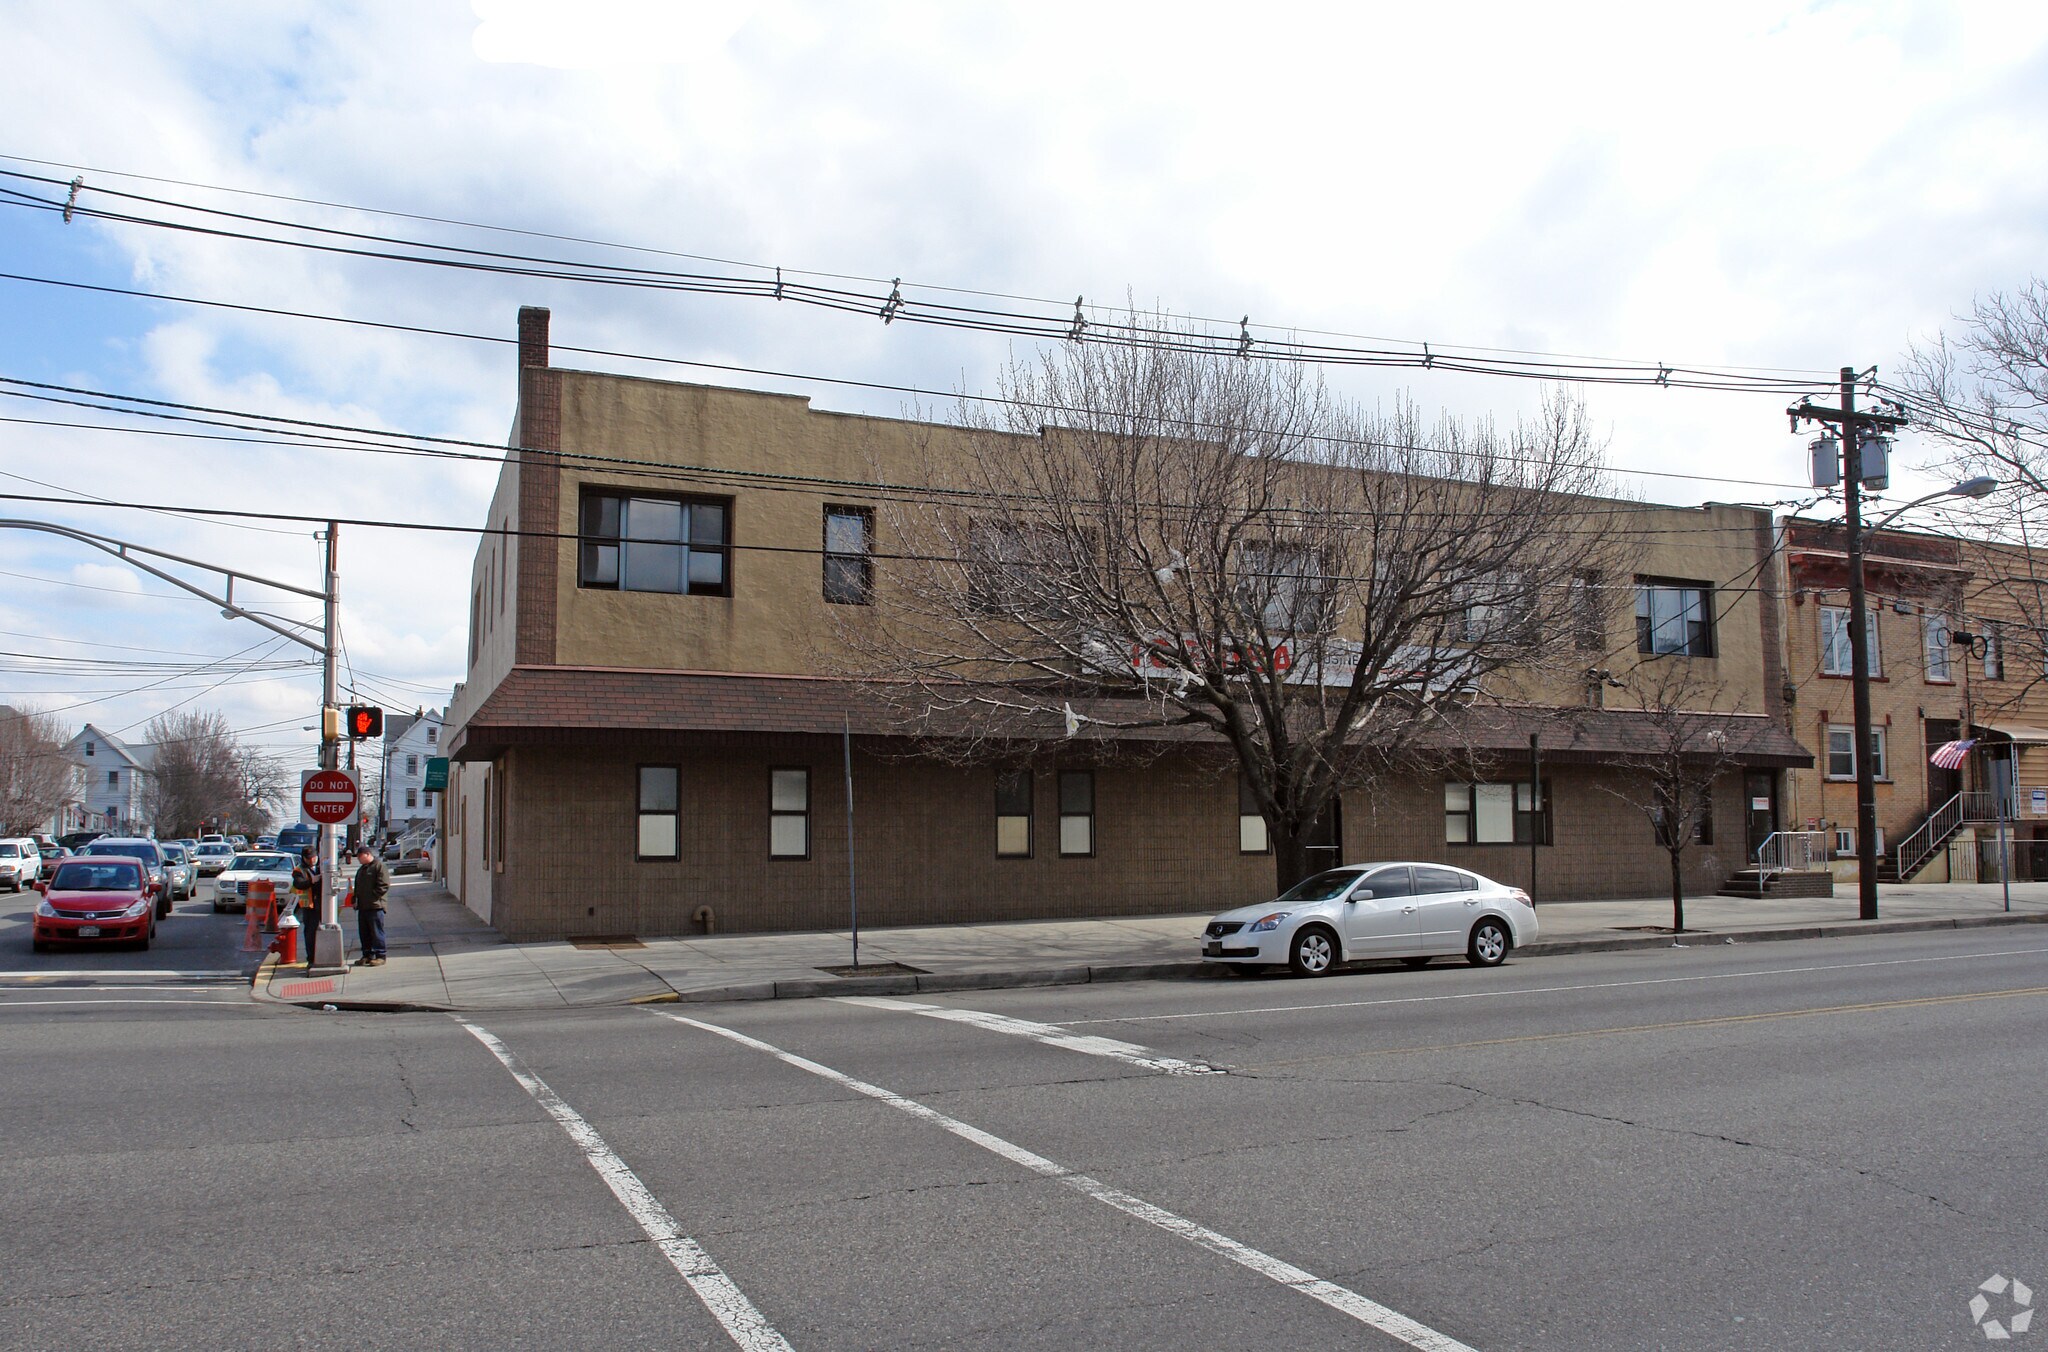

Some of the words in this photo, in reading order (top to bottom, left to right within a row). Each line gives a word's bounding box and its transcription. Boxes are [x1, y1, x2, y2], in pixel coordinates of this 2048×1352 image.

[310, 781, 324, 790] DO
[330, 781, 350, 790] NOT
[313, 805, 345, 814] ENTER
